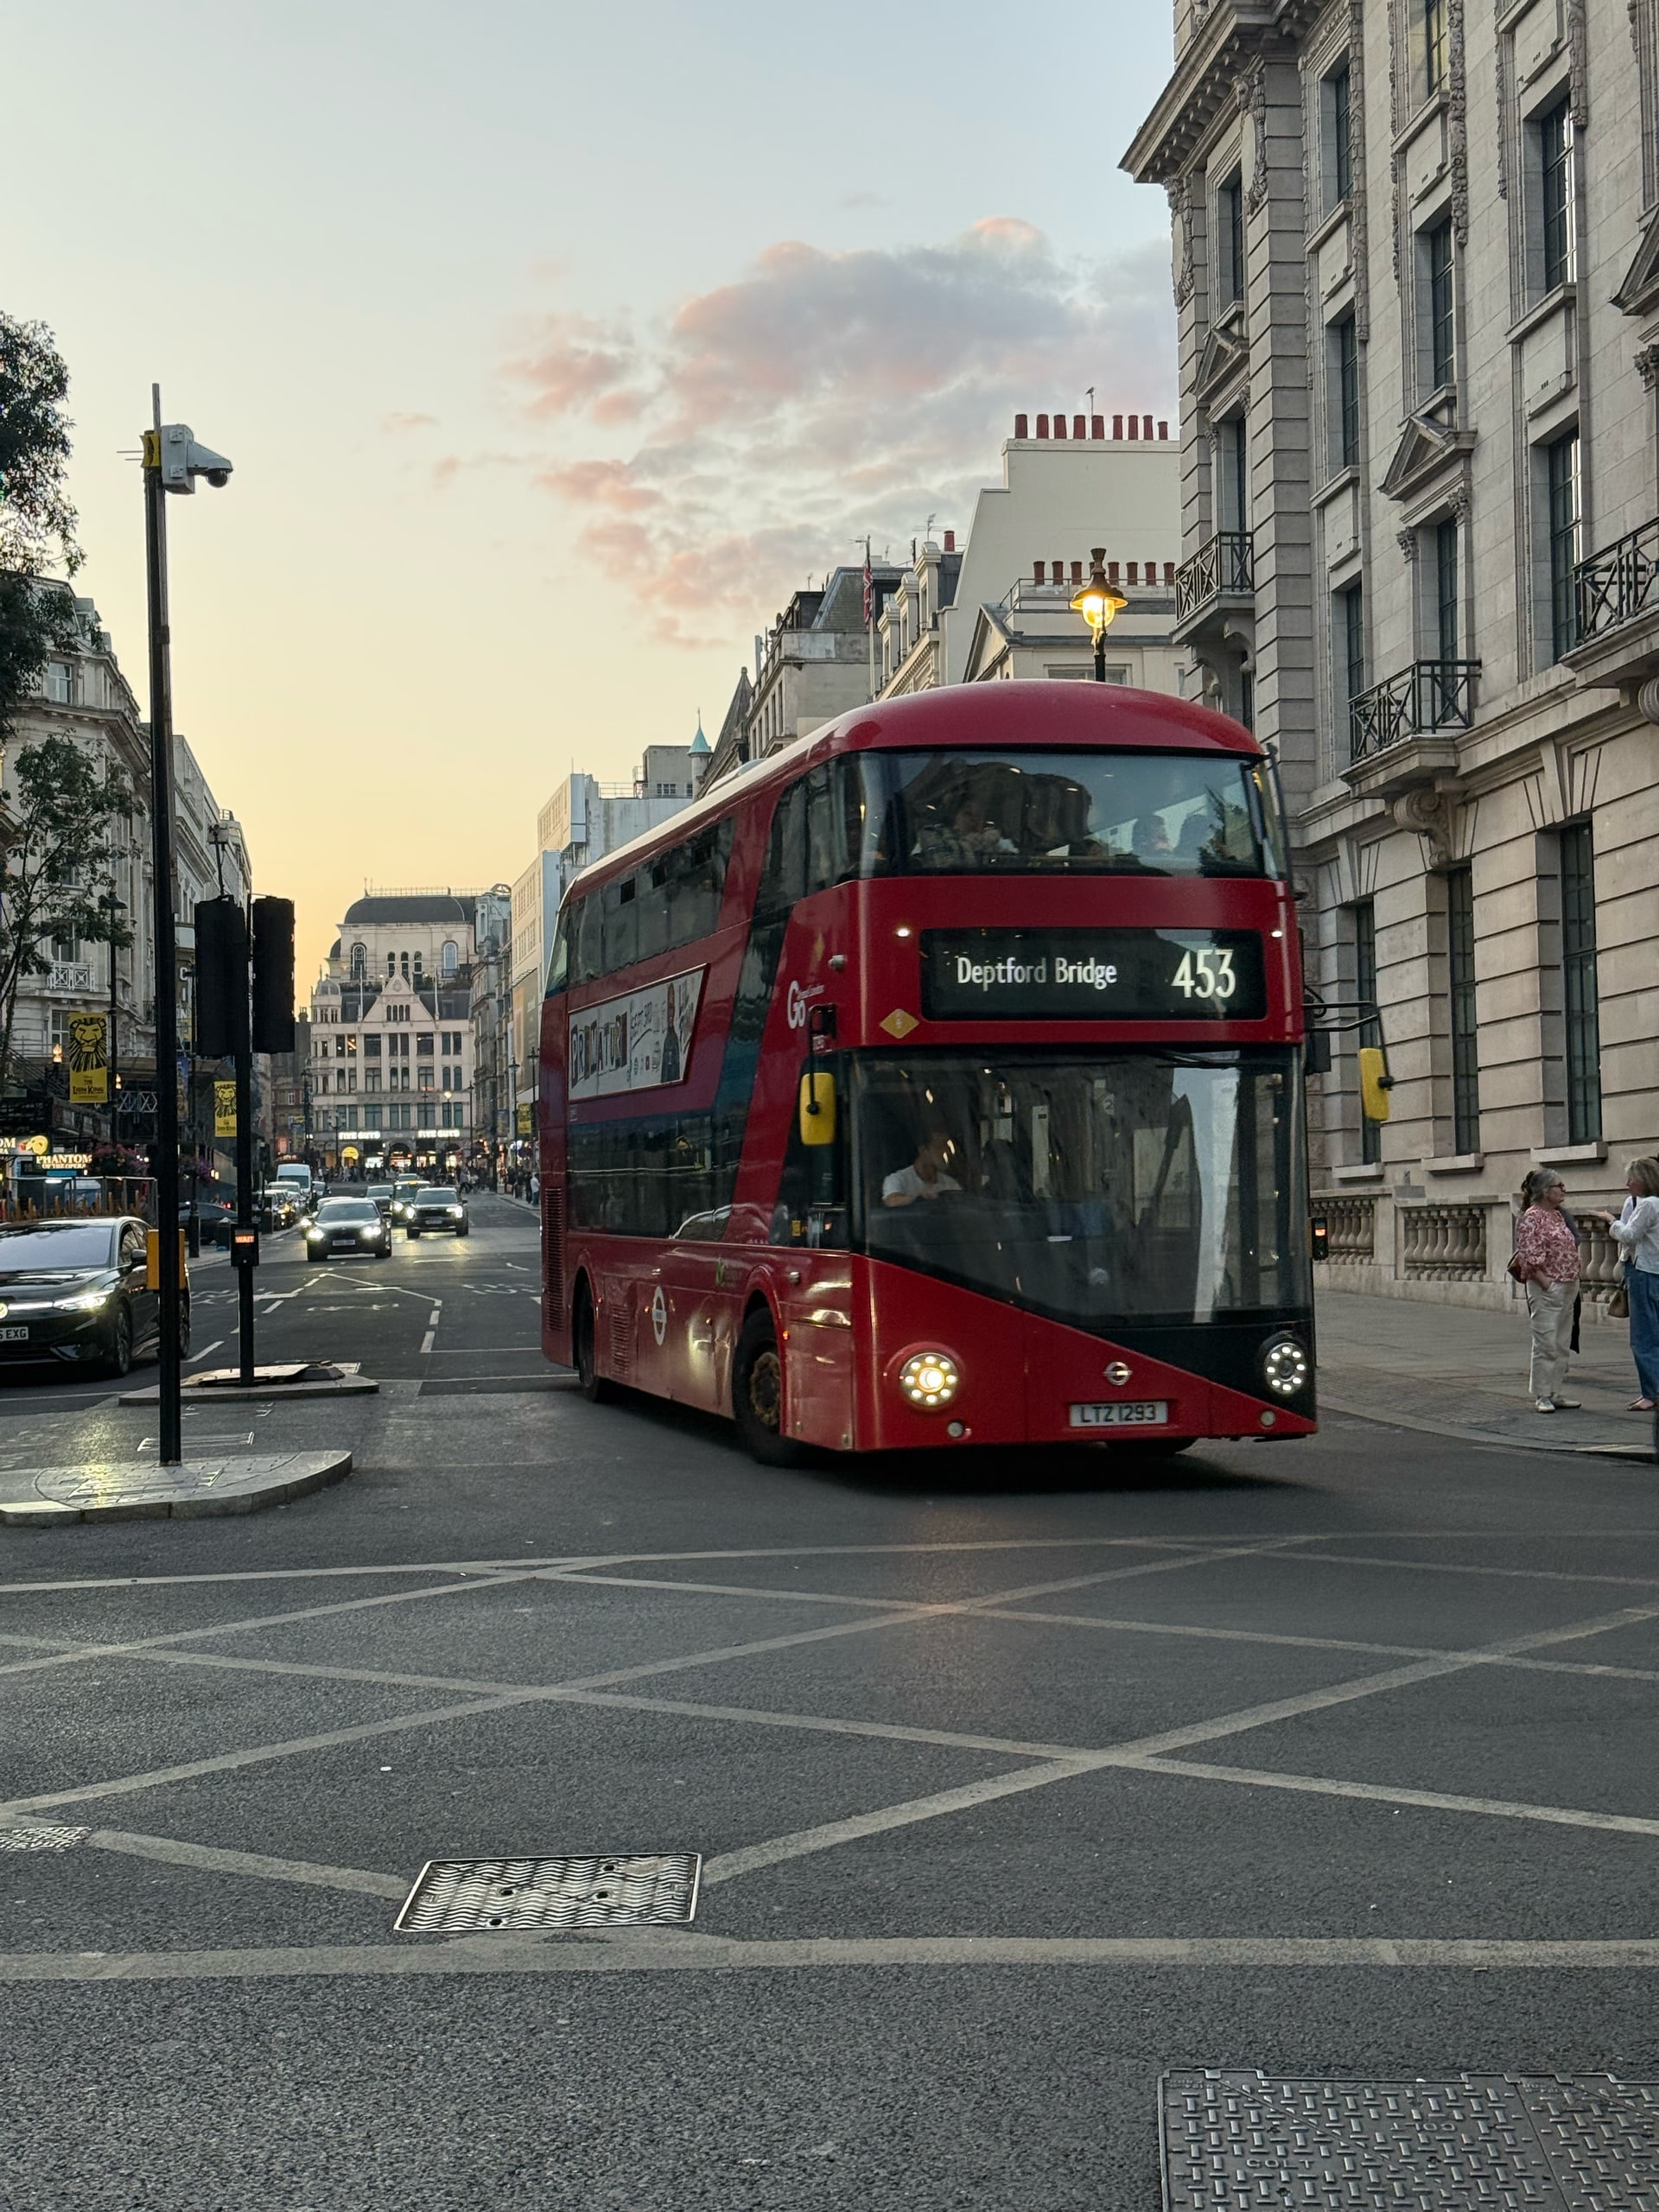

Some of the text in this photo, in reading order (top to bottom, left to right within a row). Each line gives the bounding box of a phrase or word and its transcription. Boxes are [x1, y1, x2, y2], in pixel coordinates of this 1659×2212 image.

[957, 957, 1117, 992] Deptford Bridge
[1171, 949, 1236, 998] 453
[6, 1328, 27, 1339] EXG
[1246, 2158, 1314, 2170] COLT
